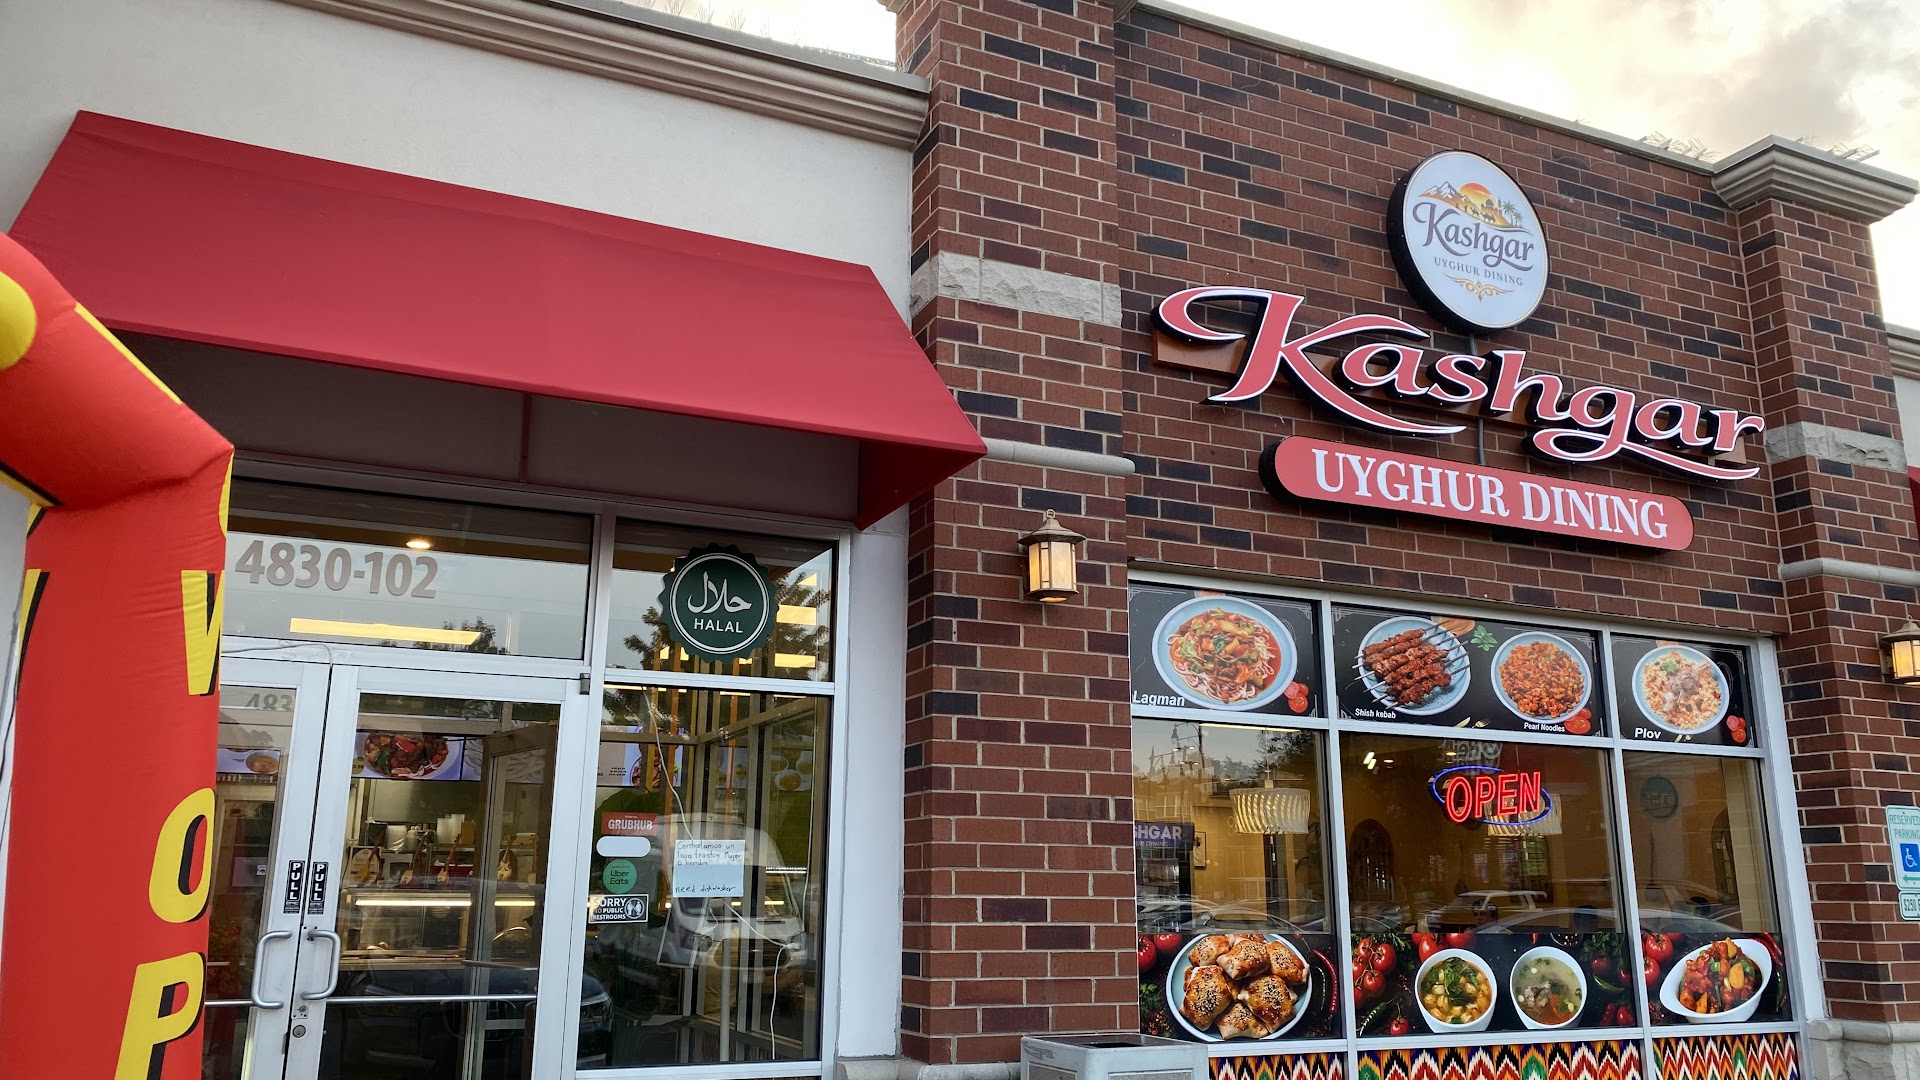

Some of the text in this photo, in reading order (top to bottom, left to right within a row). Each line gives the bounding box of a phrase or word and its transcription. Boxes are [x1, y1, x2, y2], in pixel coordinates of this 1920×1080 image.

[1412, 201, 1535, 271] Kashgar
[1434, 256, 1523, 286] UYGHUR DINING
[1156, 285, 1765, 480] Kashgar
[1312, 448, 1668, 539] UYGHUR DINING
[235, 539, 438, 599] 4830-102
[687, 570, 753, 614] حلال
[693, 617, 744, 633] HALAL
[1132, 690, 1185, 706] Lagman
[1355, 708, 1397, 719] Shish kebab
[1523, 721, 1566, 733] Pearl Noodles
[1634, 727, 1662, 739] Plov
[1446, 771, 1541, 823] OPEN
[607, 819, 653, 831] GRUBHUB
[290, 862, 301, 900] PULL
[313, 864, 325, 900] PULL
[610, 869, 629, 877] Uber
[675, 885, 696, 894] need
[593, 897, 627, 907] SORRY
